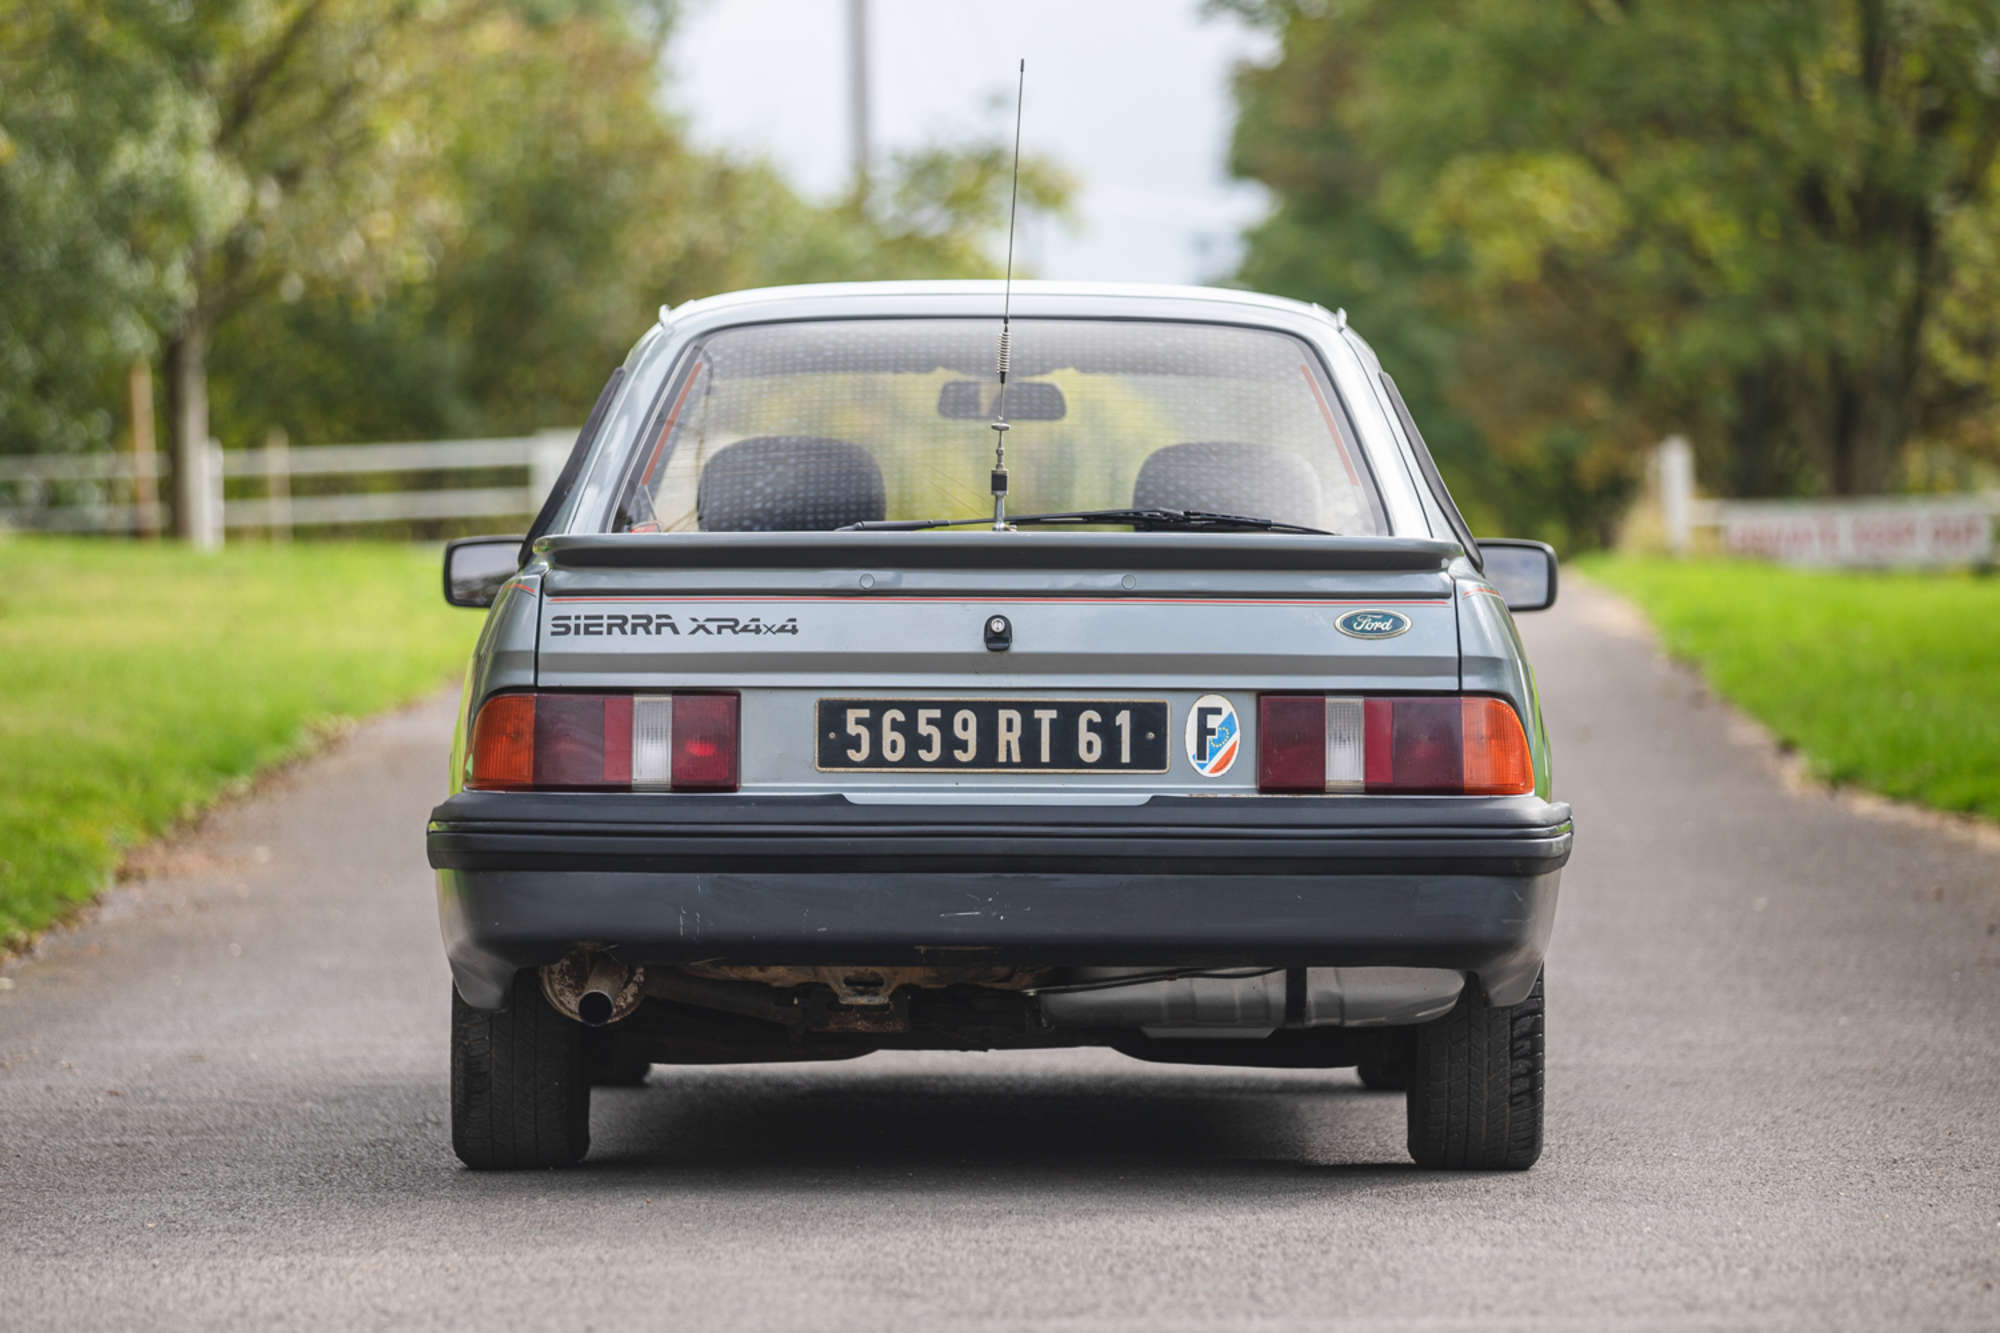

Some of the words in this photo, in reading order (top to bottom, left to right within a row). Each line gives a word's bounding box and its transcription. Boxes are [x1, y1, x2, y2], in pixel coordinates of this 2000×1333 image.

[550, 614, 680, 636] SIERRA
[1353, 614, 1393, 631] Ford
[846, 709, 978, 762] 5659
[997, 709, 1058, 763] RT
[1078, 709, 1132, 763] 61
[1198, 707, 1223, 761] F
